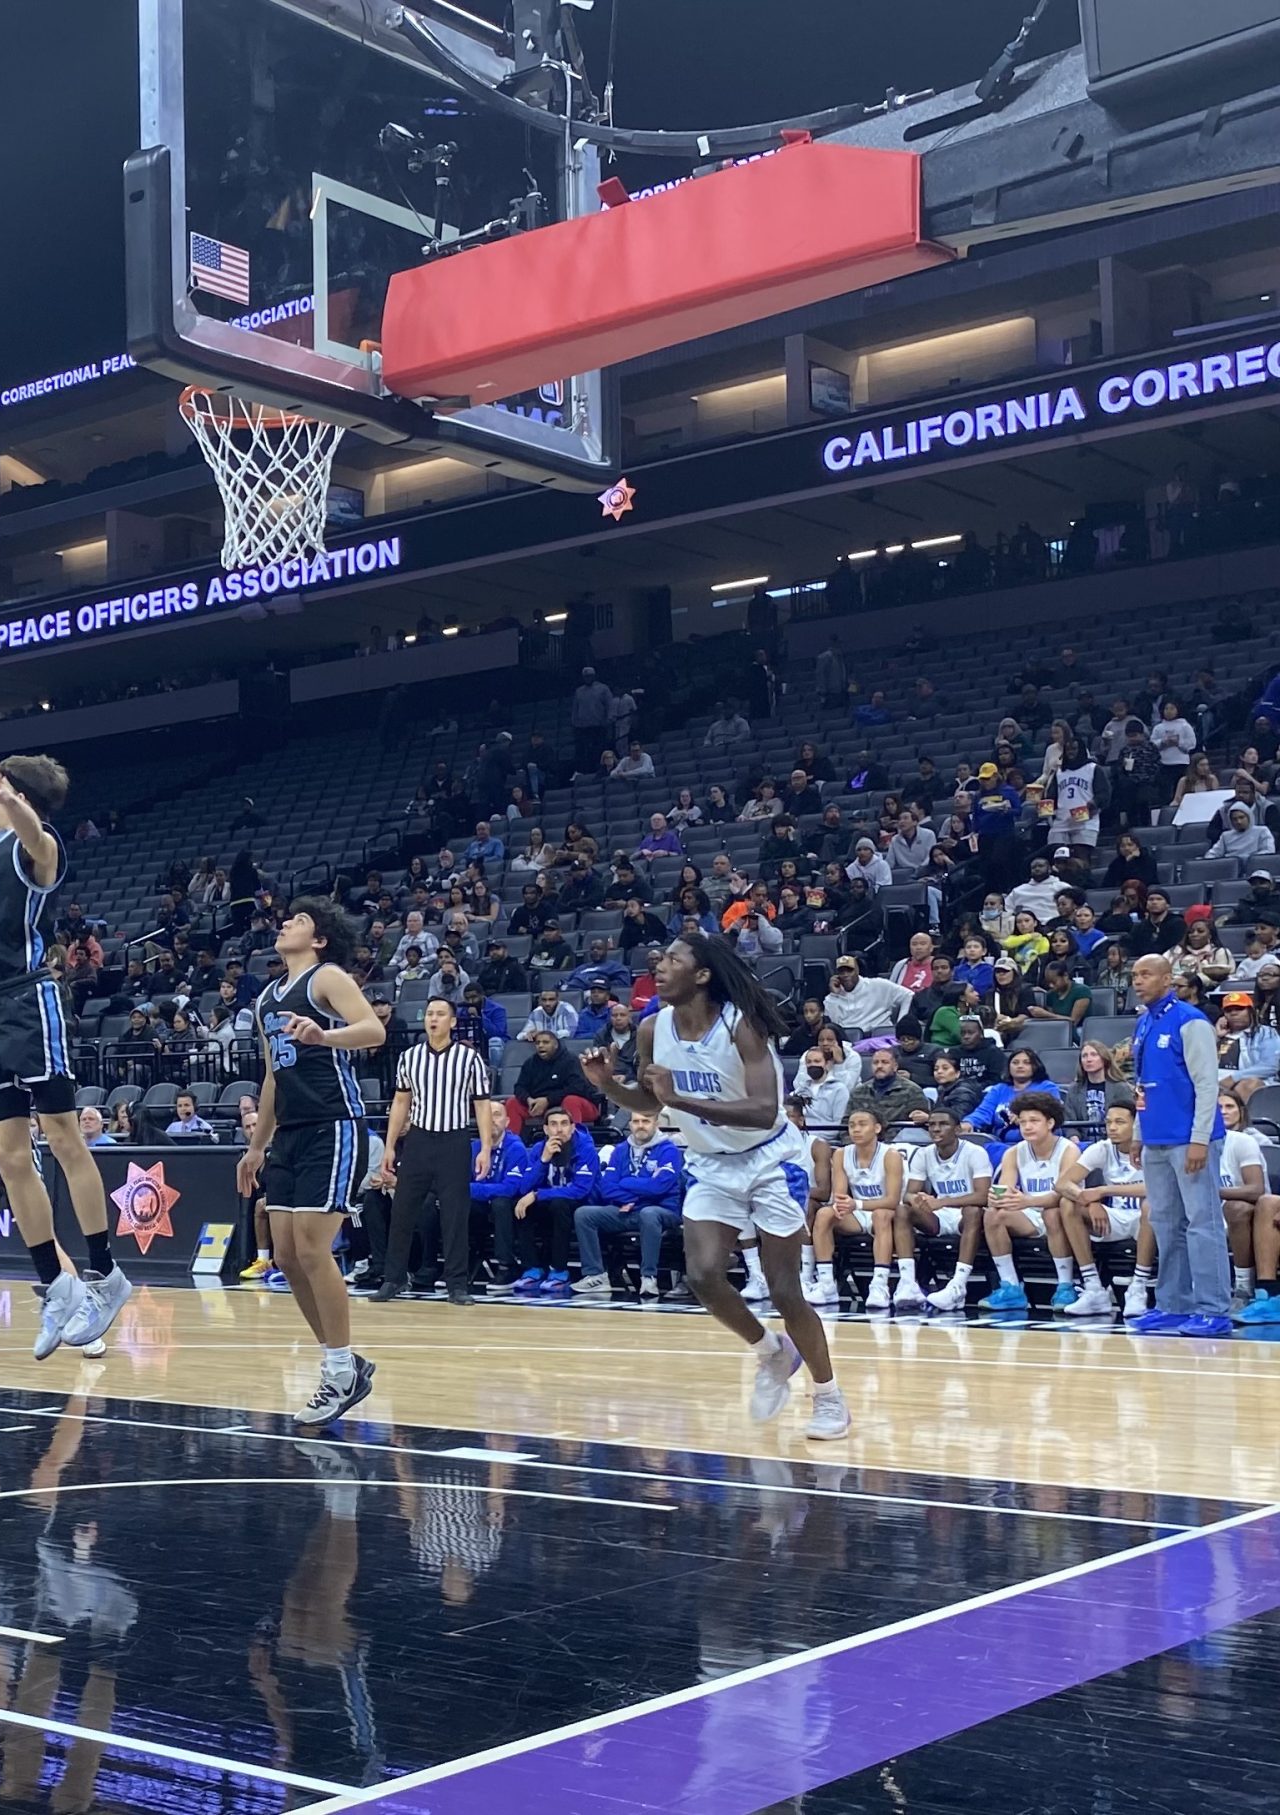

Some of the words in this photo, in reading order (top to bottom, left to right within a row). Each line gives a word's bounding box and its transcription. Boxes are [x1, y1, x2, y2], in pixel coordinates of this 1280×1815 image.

[225, 294, 315, 331] SSOCIATIO
[1, 363, 101, 406] CORRECTIONAL
[103, 353, 137, 375] PEAC
[823, 387, 1086, 471] CALIFORNIA
[77, 583, 199, 632] OFFICERS
[206, 537, 401, 606] ASSOCIATION
[937, 1178, 968, 1195] WILDCATS
